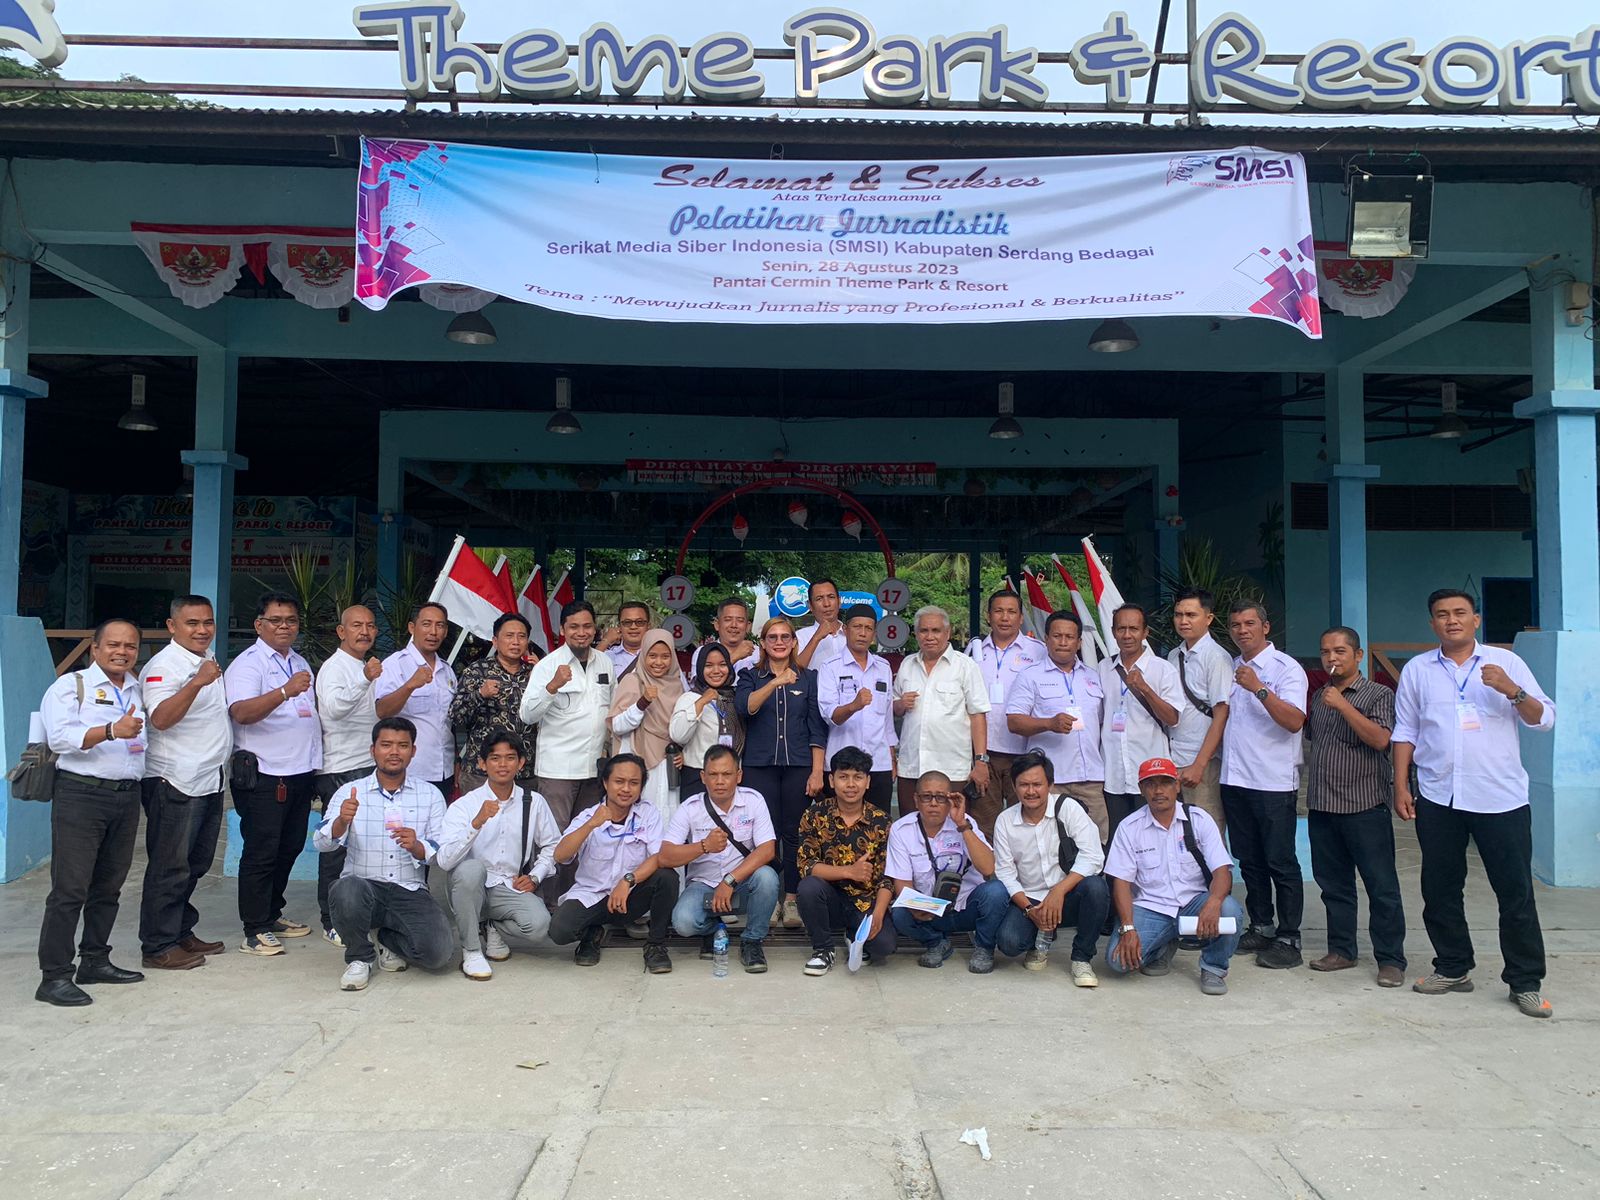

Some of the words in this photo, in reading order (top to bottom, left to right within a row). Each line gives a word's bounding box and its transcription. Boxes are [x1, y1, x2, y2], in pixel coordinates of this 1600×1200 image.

[353, 0, 765, 101] Theme
[783, 7, 1049, 103] Park
[1070, 11, 1156, 105] &
[1198, 12, 1600, 108] Resort
[1214, 155, 1294, 182] SMSI
[653, 163, 834, 191] Selamat
[849, 164, 882, 191] &
[900, 164, 1045, 191] Sukses
[771, 192, 809, 202] Atas
[815, 192, 942, 203] Terlaksananya
[669, 204, 824, 236] Pelatihan
[831, 206, 1010, 238] Jurnalistik
[546, 239, 612, 255] Serikat
[616, 240, 672, 253] Media
[677, 239, 727, 253] Siber
[732, 239, 823, 253] Indonesia
[829, 239, 888, 256] (SMSI)
[894, 241, 993, 259] Kabupaten
[998, 244, 1073, 264] Serdang
[1079, 246, 1154, 261] Bedagai
[762, 260, 813, 273] Senin,
[818, 261, 839, 272] 28
[844, 261, 913, 276] Agustus
[917, 262, 959, 275] 2023
[713, 276, 766, 288] Pantai
[771, 276, 832, 288] Cermin
[836, 276, 893, 289] Theme
[897, 278, 934, 290] Park
[939, 280, 951, 291] &
[956, 281, 1009, 292] Resort
[524, 283, 584, 302] Tema
[755, 300, 839, 313] Jurnalis
[845, 303, 898, 315] yang
[903, 300, 1024, 313] Profesional
[1030, 298, 1046, 308] &
[645, 461, 763, 471] DIRGAHAYU
[236, 520, 270, 529] PARK
[104, 556, 191, 564] DIRGAHAY
[666, 585, 686, 601] 17
[882, 589, 902, 604] 17
[673, 624, 683, 639] 8
[887, 625, 897, 640] 8
